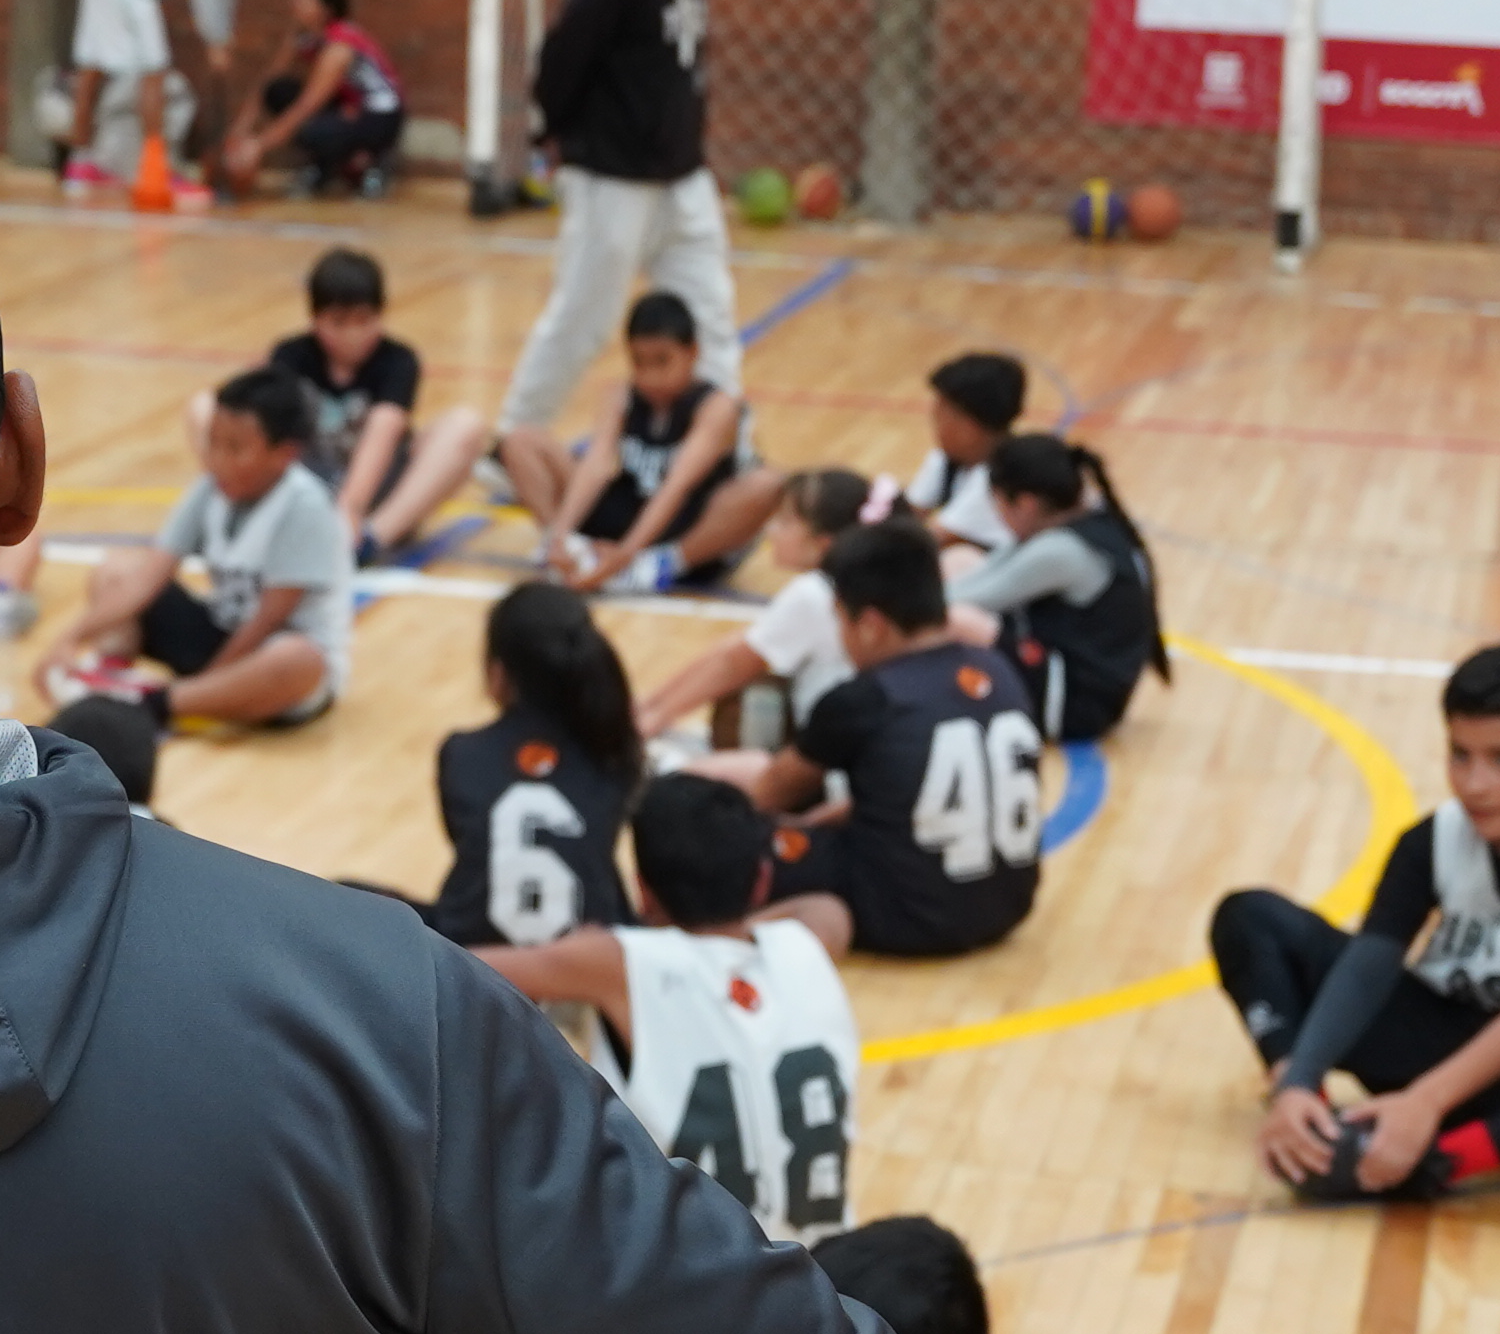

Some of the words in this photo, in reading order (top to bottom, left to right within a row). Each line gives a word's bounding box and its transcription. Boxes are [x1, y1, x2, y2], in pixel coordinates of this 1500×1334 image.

[487, 781, 586, 947] 6
[912, 710, 1041, 883] 46
[669, 1043, 850, 1234] 48
